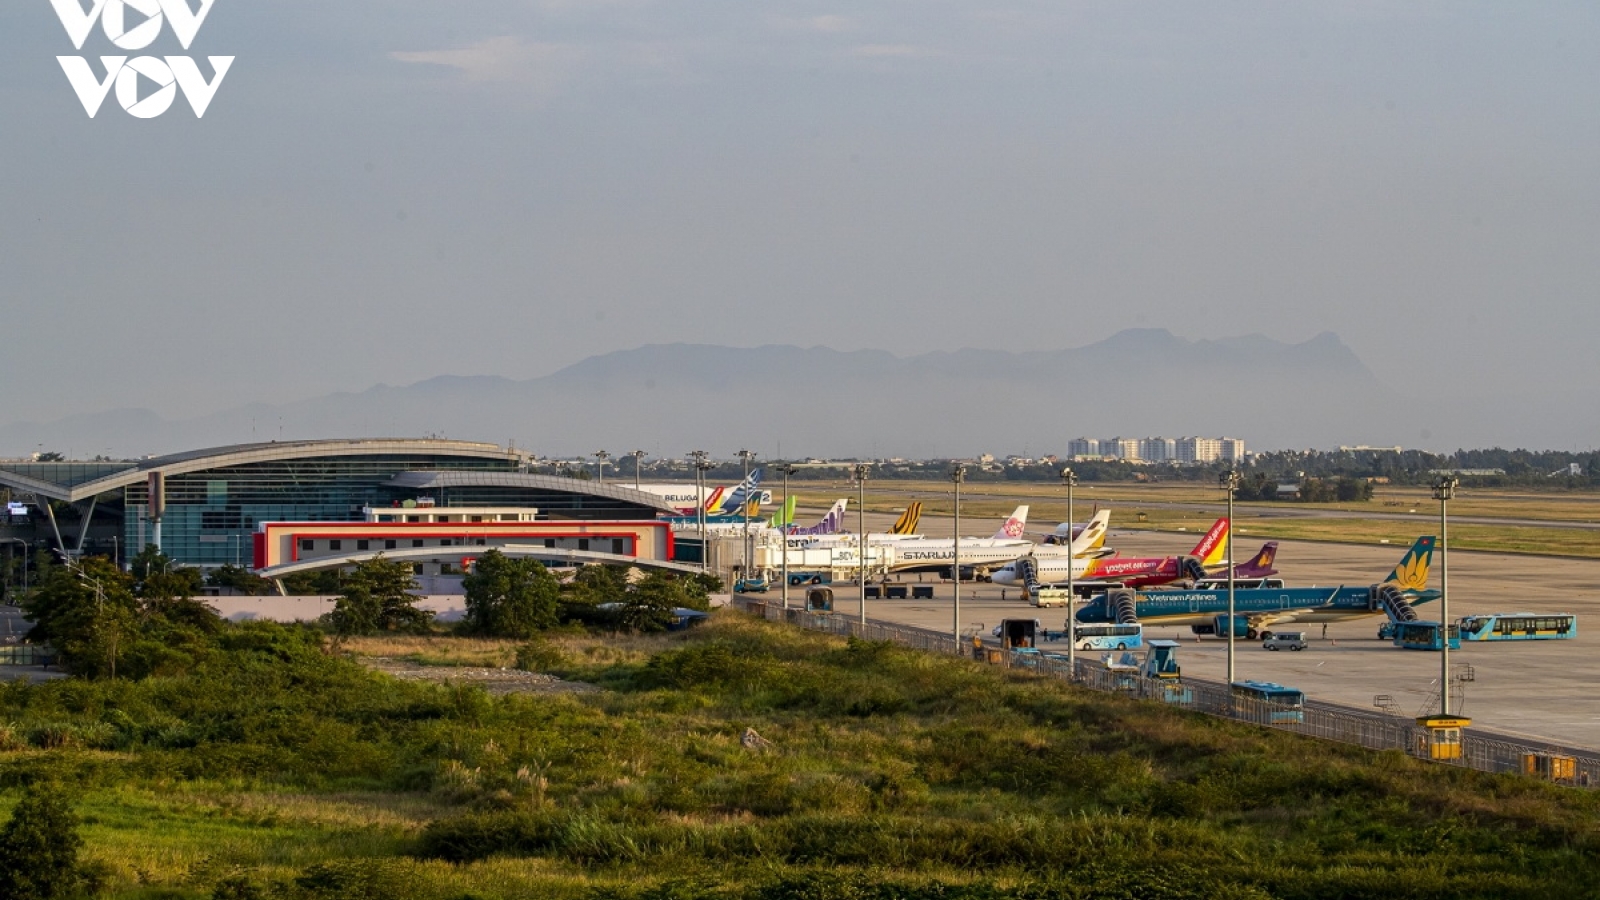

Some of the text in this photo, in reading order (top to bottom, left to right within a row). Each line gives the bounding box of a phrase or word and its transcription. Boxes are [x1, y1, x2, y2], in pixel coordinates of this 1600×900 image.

[665, 494, 698, 502] BELUGA
[762, 493, 770, 501] 2
[1148, 593, 1217, 602] Vietnam Airlines
